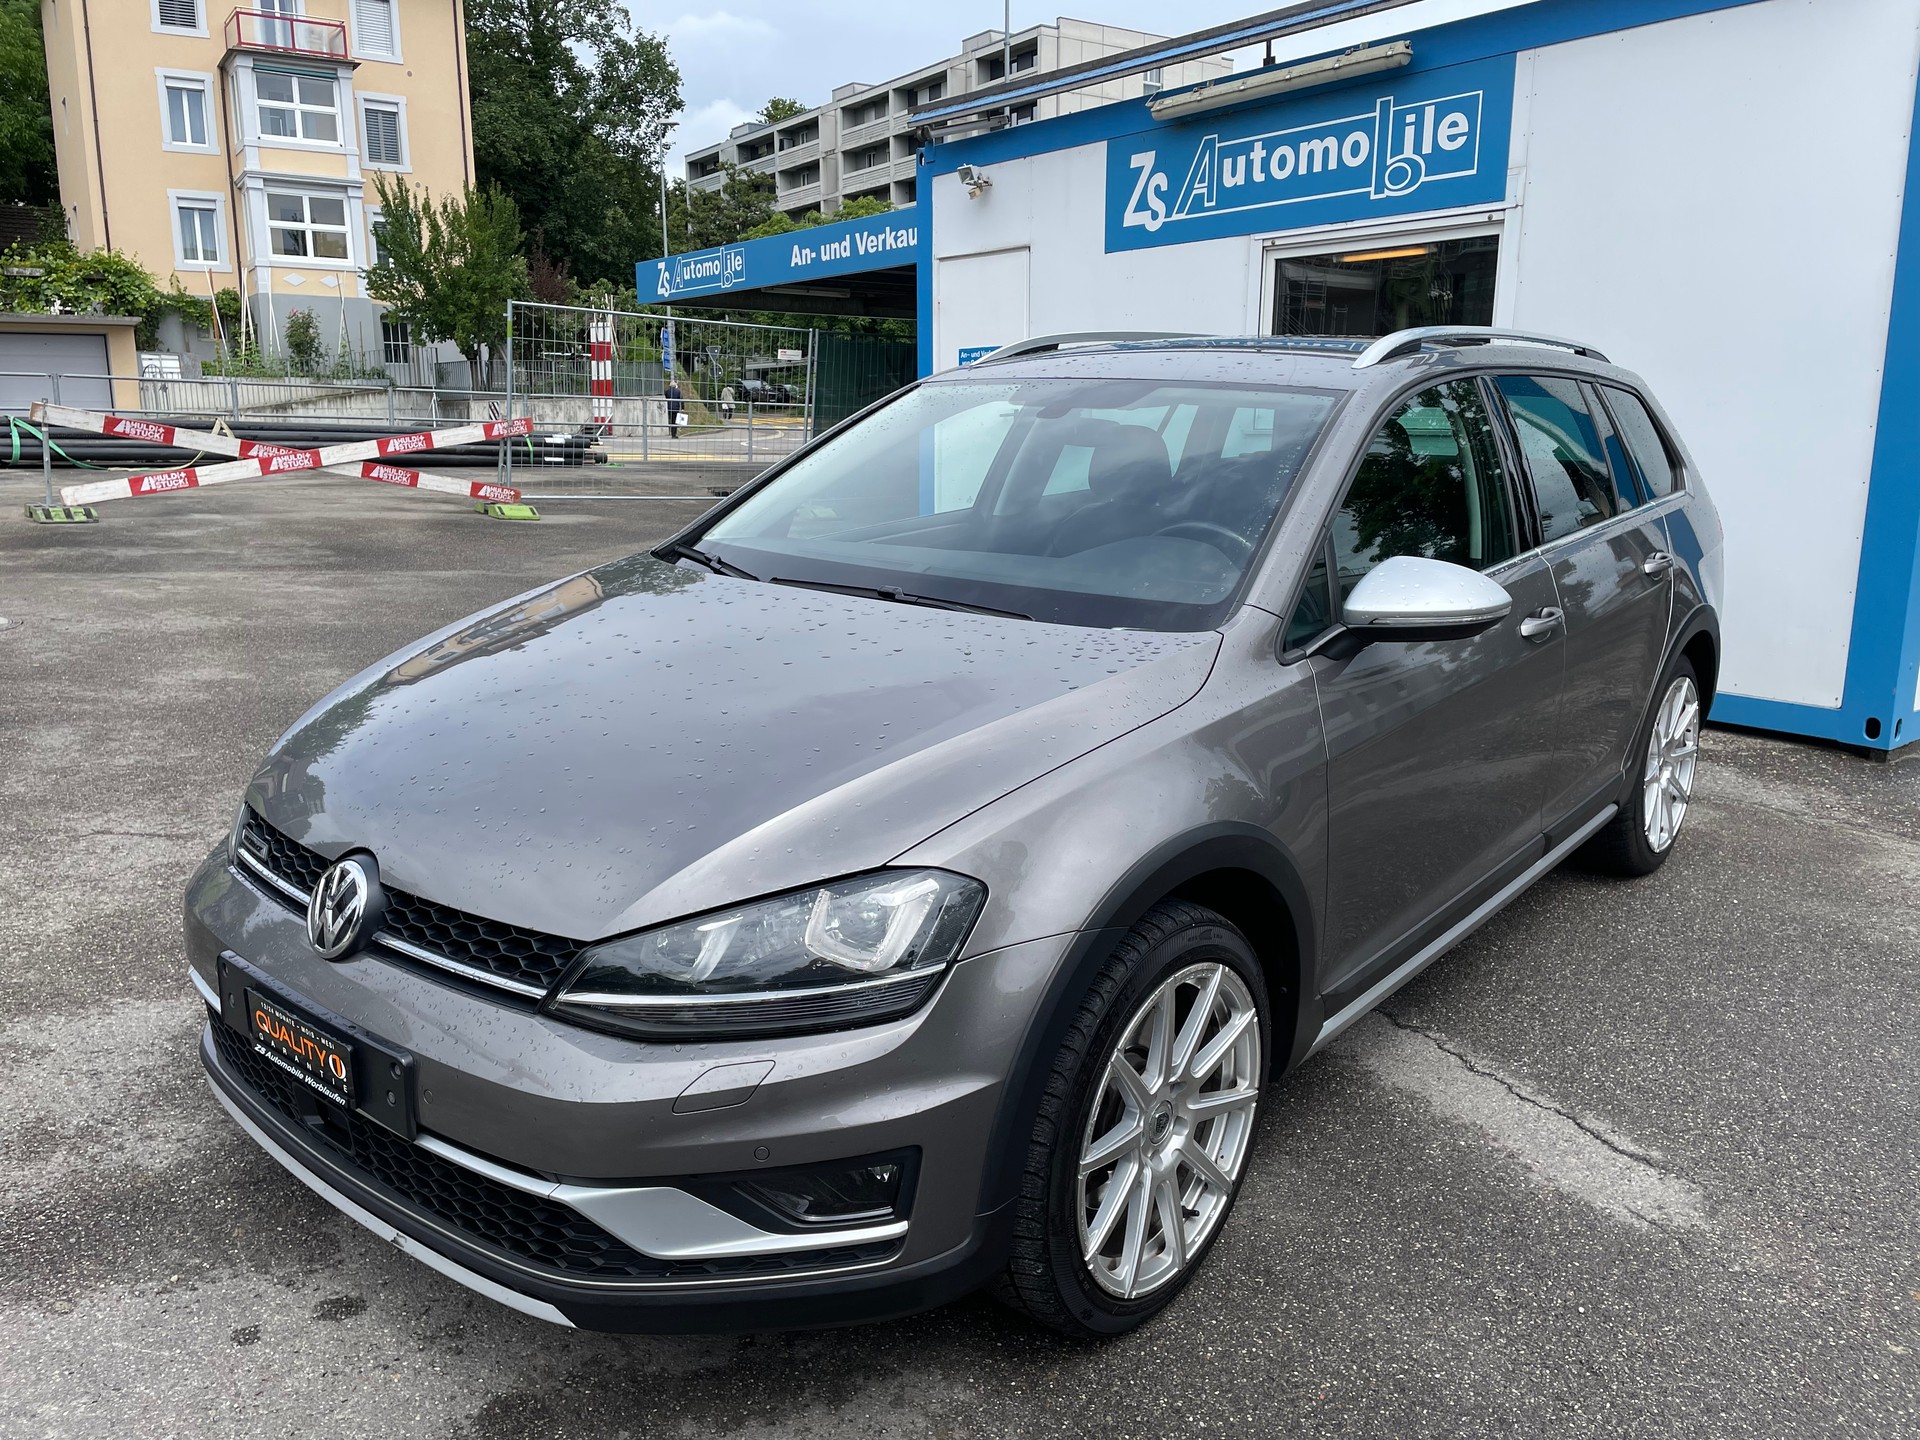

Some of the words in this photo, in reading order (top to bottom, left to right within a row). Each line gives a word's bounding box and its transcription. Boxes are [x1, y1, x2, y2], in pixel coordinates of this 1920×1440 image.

[1173, 96, 1470, 219] Automobile
[671, 247, 743, 292] Automobile
[790, 244, 816, 268] An-
[820, 234, 850, 262] und
[855, 226, 918, 255] Verkau
[971, 350, 981, 358] und
[258, 1032, 348, 1093] GARANTIE
[265, 1050, 304, 1079] Automobile
[304, 1075, 346, 1106] Worblaufen
